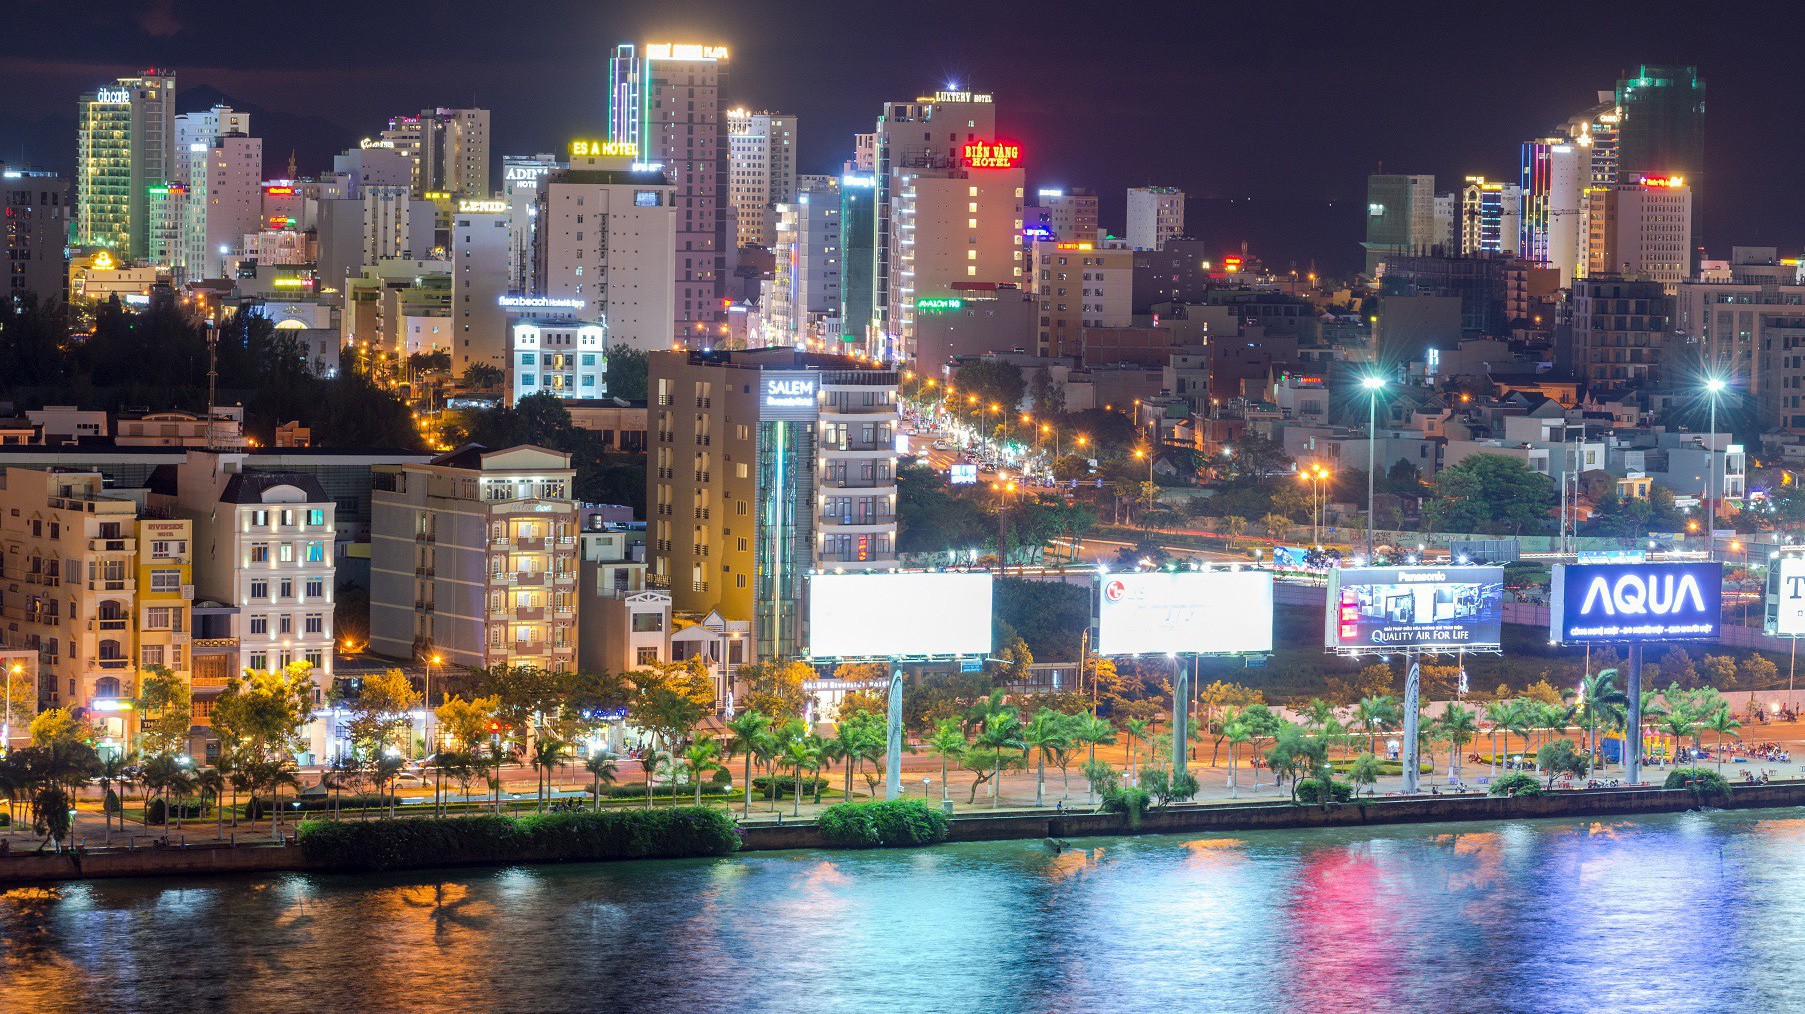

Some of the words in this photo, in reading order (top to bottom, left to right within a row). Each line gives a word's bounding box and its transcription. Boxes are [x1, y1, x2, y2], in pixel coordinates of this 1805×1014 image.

[935, 91, 971, 102] LUXTERY
[973, 94, 993, 103] HOTEL
[602, 142, 638, 155] HOTEL
[993, 143, 1018, 159] VÀNG
[972, 157, 1011, 167] HOTEL
[767, 380, 814, 395] SALEM
[148, 523, 184, 531] RIVERSIDE
[1398, 570, 1446, 582] Panasonic
[1580, 574, 1706, 615] AQUA
[1371, 629, 1413, 644] QUALITY
[1415, 631, 1431, 640] AIR
[1433, 630, 1450, 640] FOR
[1452, 629, 1469, 640] LIFE
